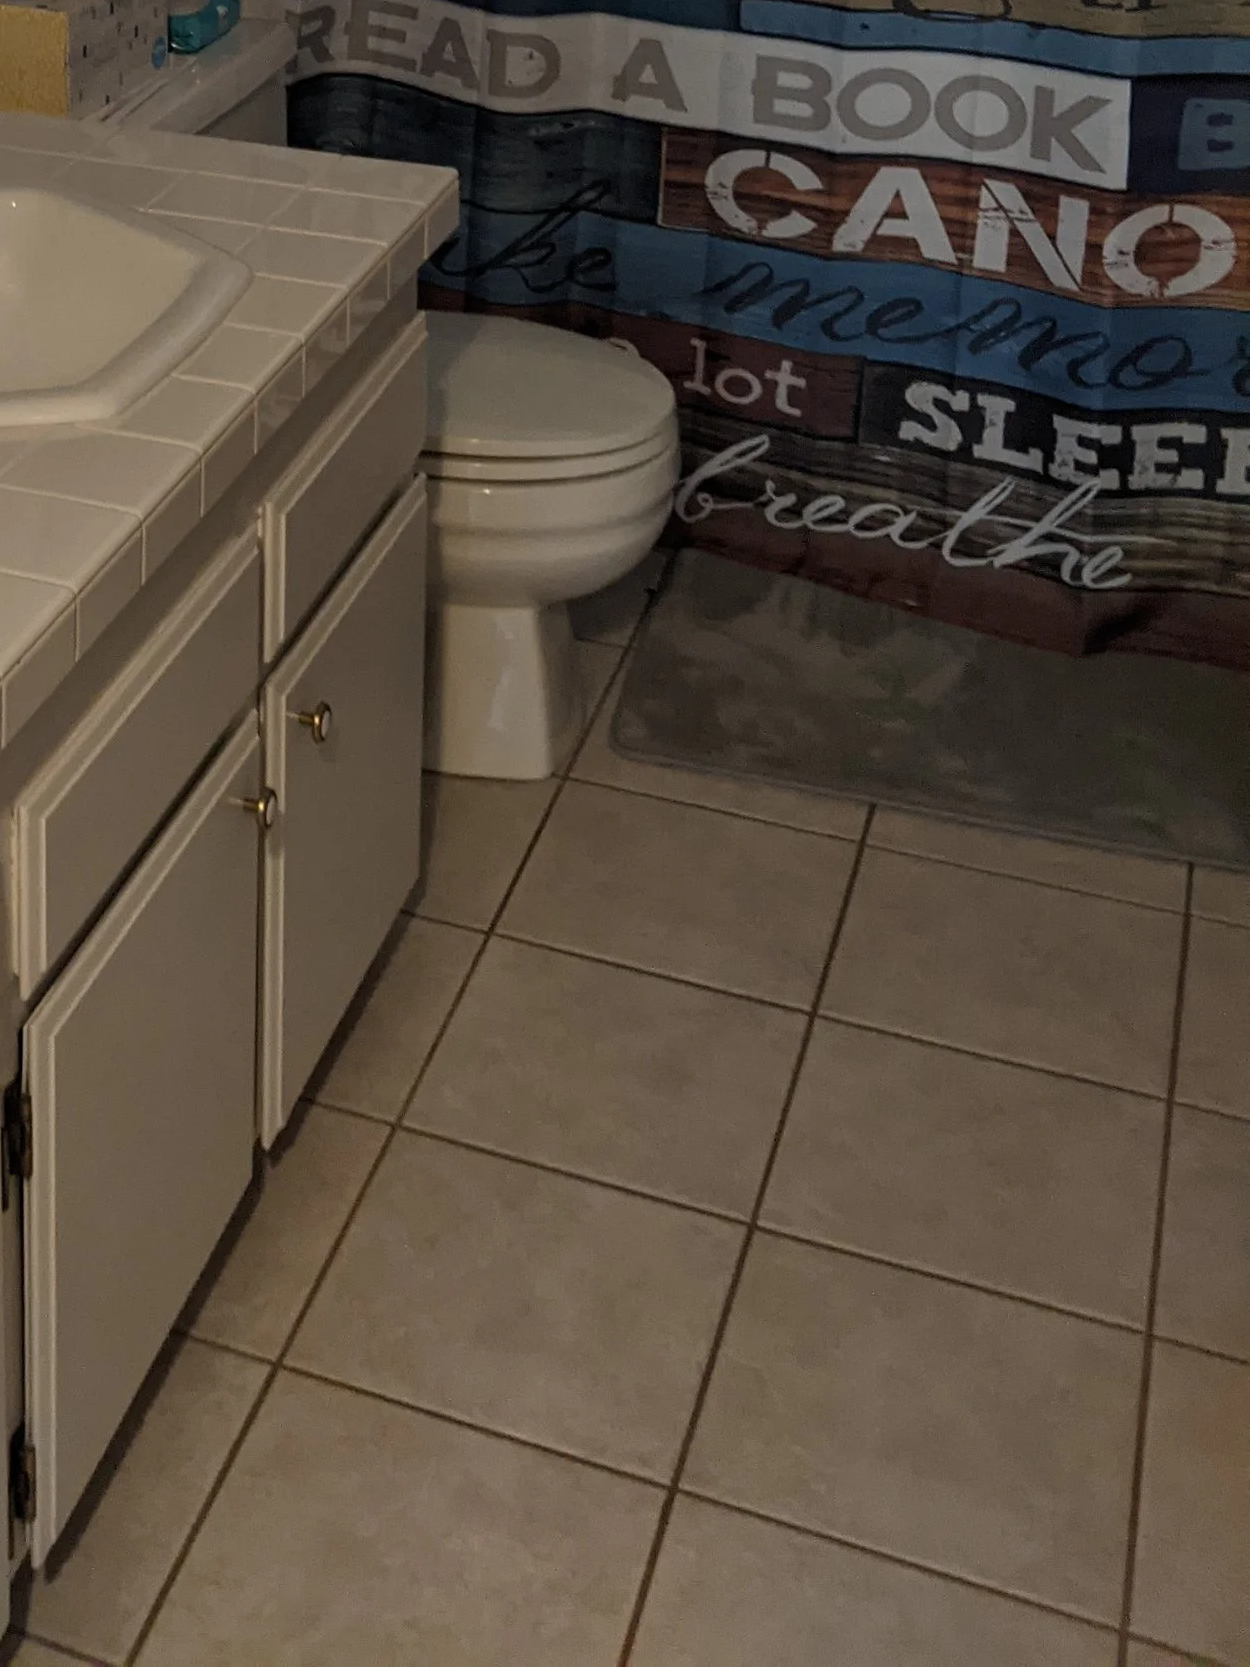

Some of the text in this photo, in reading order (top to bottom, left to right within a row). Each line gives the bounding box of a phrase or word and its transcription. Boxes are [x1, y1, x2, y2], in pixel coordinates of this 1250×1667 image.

[611, 37, 688, 114] A
[751, 53, 1113, 175] BOOK
[703, 147, 1238, 300] CANO
[683, 337, 807, 418] lot
[672, 434, 1134, 590] breathe
